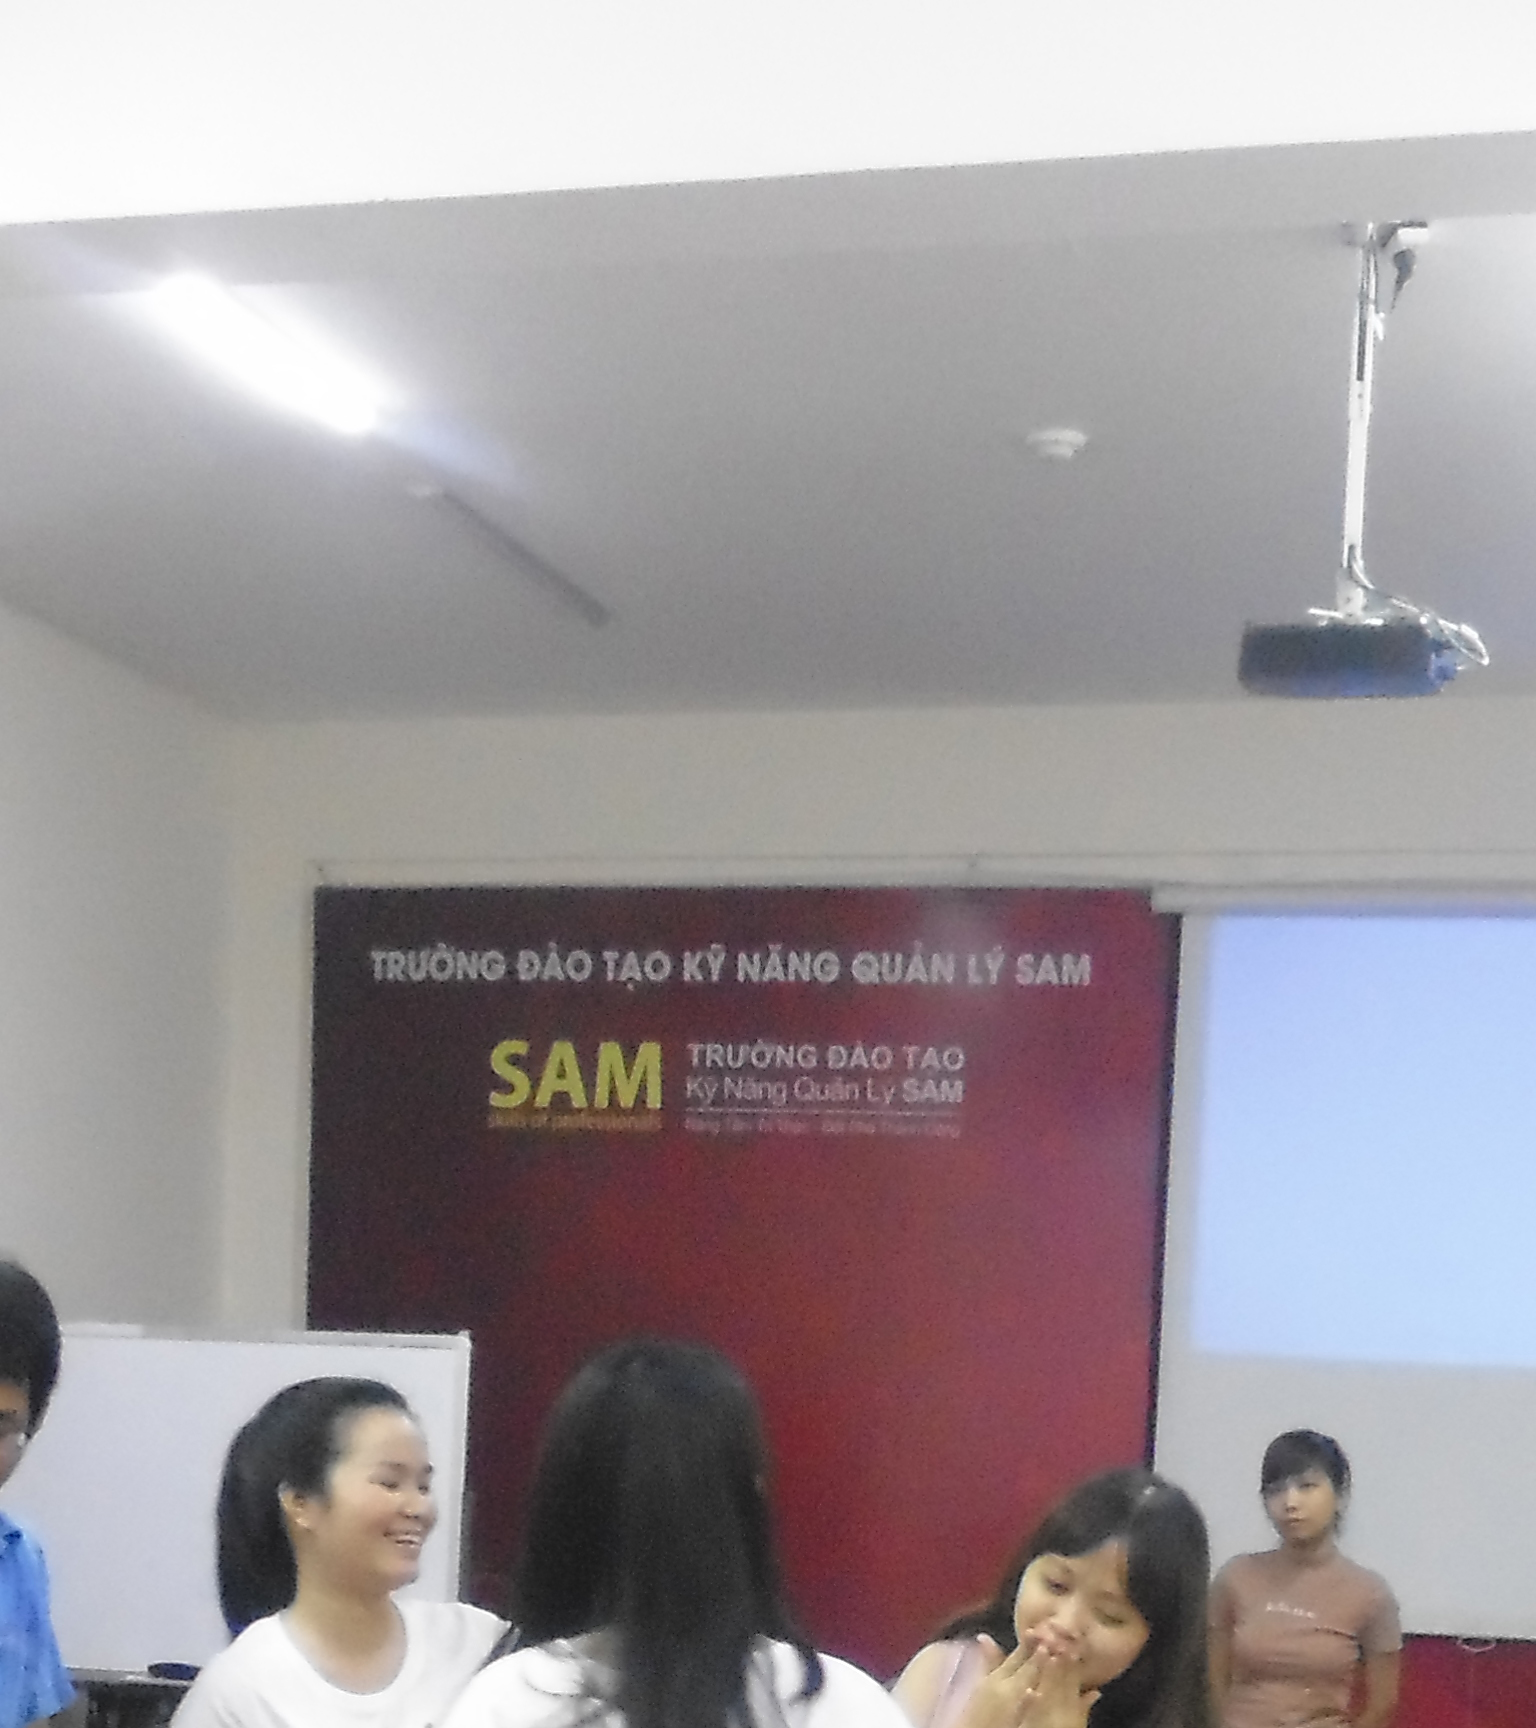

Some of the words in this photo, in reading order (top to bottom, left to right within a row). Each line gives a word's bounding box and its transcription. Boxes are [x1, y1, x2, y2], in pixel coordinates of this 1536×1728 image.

[370, 942, 506, 982] TRƯỜNG
[516, 941, 593, 982] ĐÀO
[602, 949, 671, 990] TẠO
[682, 942, 727, 983] KỸ
[737, 942, 841, 984] NĂNG
[851, 940, 956, 985] QUẢN
[967, 944, 1006, 986] LÝ
[1015, 952, 1092, 987] SAM
[488, 1039, 663, 1109] SAM
[686, 1038, 818, 1070] TRƯỜNG
[902, 1078, 964, 1104] SAM
